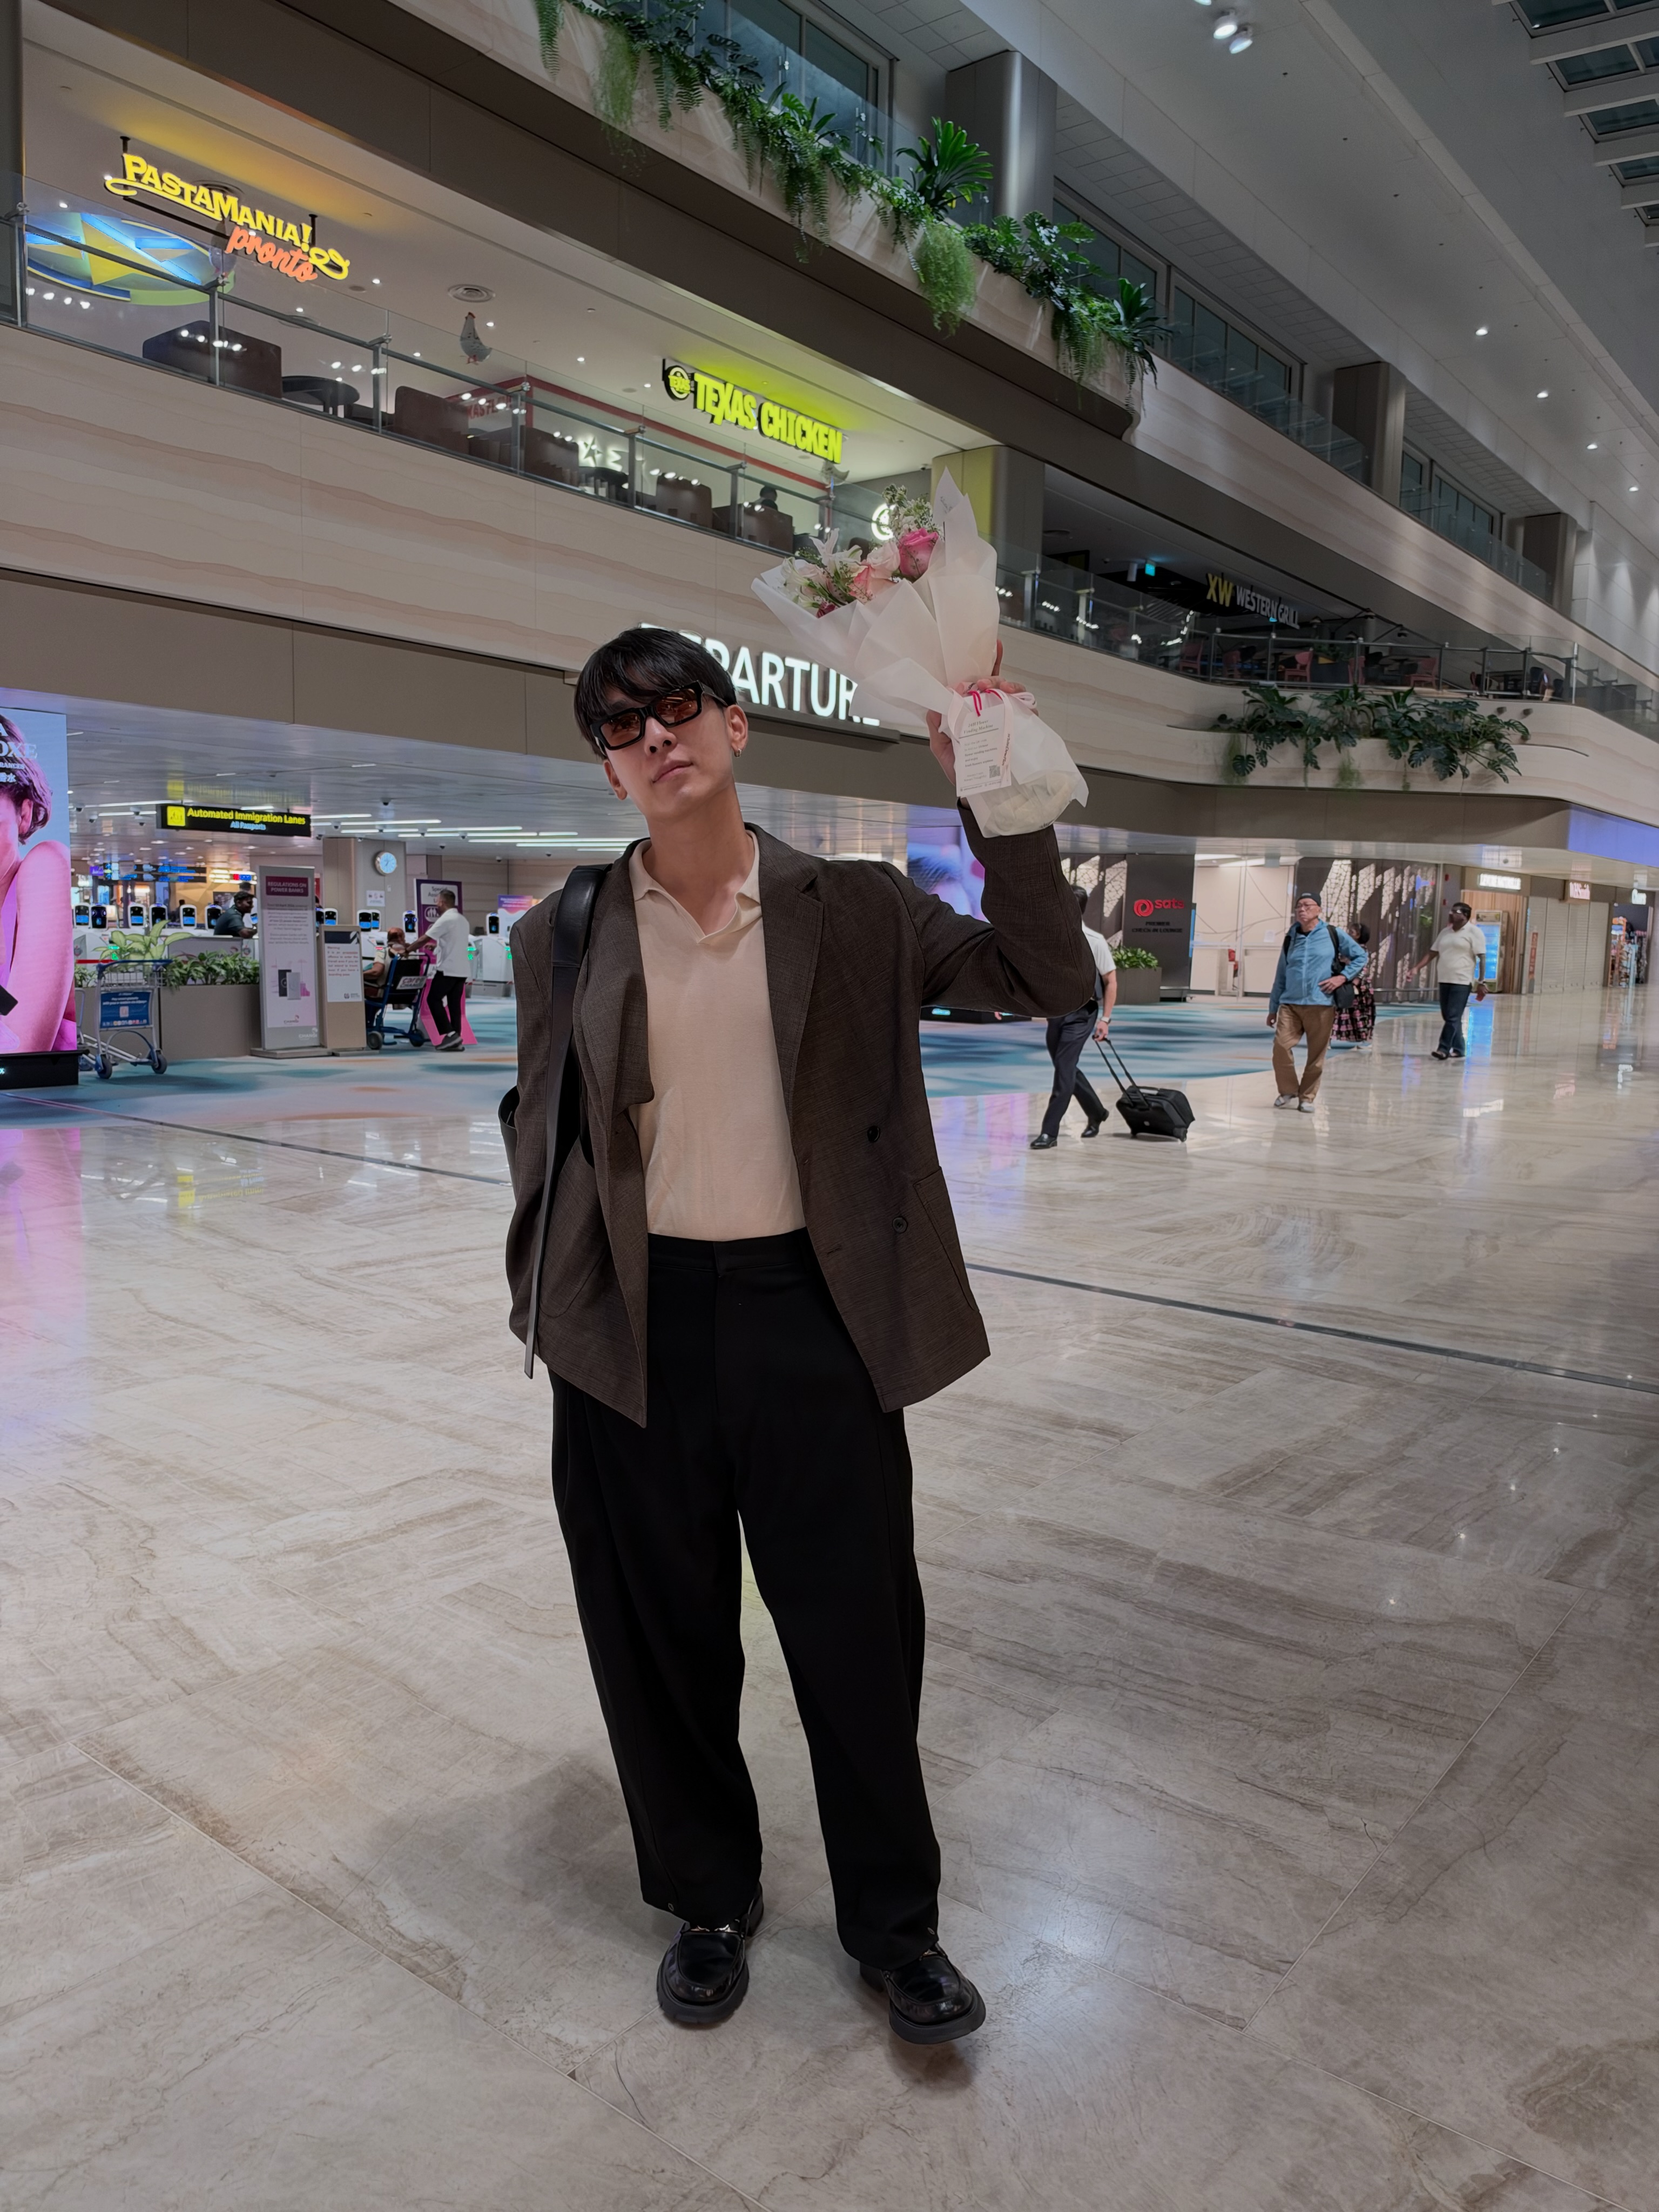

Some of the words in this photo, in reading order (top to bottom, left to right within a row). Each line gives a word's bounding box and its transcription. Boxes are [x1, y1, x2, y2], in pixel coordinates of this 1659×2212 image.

[224, 226, 318, 282] pronto
[694, 373, 757, 430] TEXAS
[760, 401, 843, 464] CHICKEN
[1206, 572, 1233, 608] XW
[1236, 585, 1278, 619] WESTERN
[1278, 604, 1300, 630] GRILL
[187, 808, 233, 820] Automated
[235, 811, 282, 824] Immigration
[284, 815, 306, 825] Lanes
[1155, 898, 1184, 909] sats
